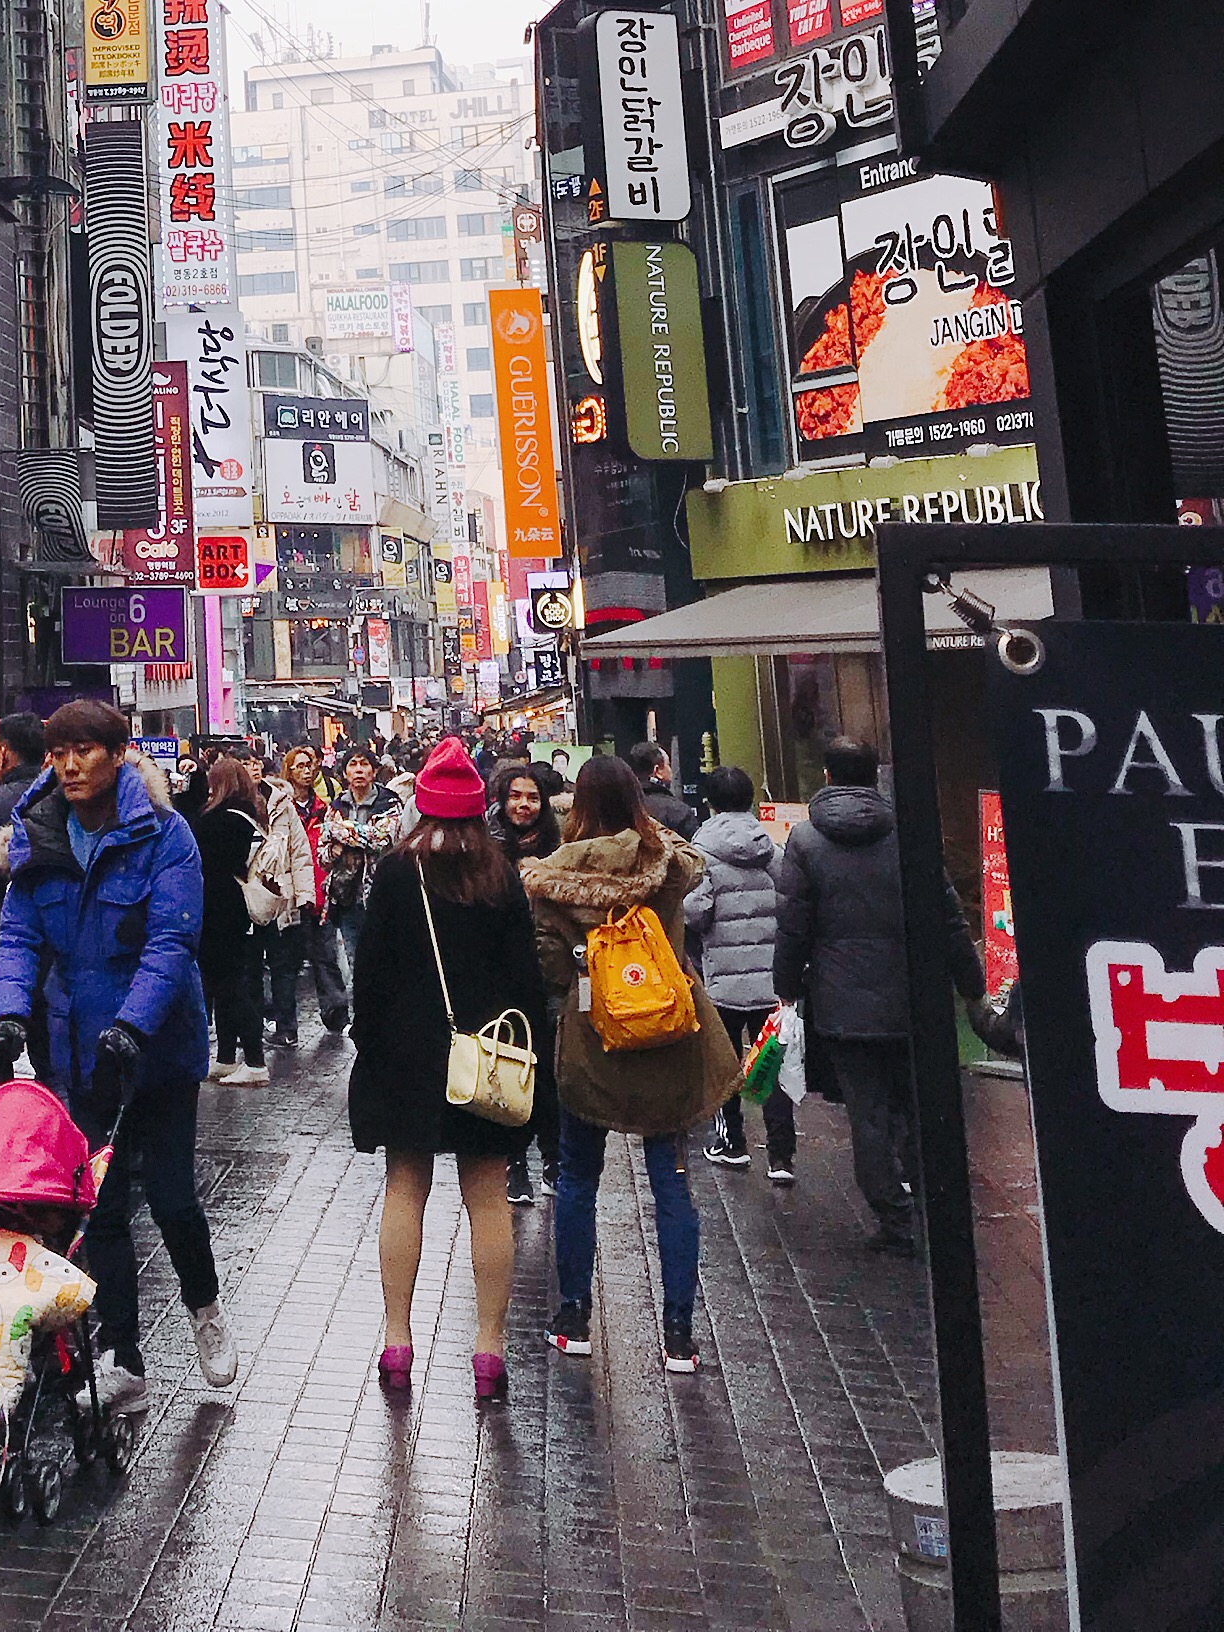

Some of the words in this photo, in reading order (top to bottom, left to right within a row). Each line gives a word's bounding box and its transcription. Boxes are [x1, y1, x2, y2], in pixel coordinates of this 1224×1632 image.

[789, 5, 809, 24] YOU
[797, 18, 813, 36] EAT
[92, 44, 140, 52] IMPROVISED
[731, 32, 772, 59] Barbeque
[160, 82, 217, 114] 마라탕
[776, 24, 894, 149] 장인
[616, 18, 662, 214] 장인닭갈비
[168, 121, 216, 224] 米线
[588, 200, 604, 223] 2F
[167, 229, 225, 262] 쌀국수
[593, 240, 607, 261] 1F
[173, 268, 219, 281] 명동2호점
[645, 243, 670, 336] NATURE
[327, 294, 388, 312] HALALFOOD
[98, 271, 134, 374] FOLDER
[353, 311, 388, 321] RESTAURANT
[931, 307, 1005, 348] JANGIN
[450, 381, 460, 421] HALAL
[653, 344, 680, 455] REPUBLIC
[301, 408, 363, 431] 리안헤어
[928, 419, 986, 442] 1522-1960
[508, 354, 544, 509] GUÉRISSON
[453, 427, 464, 463] FOOD
[434, 451, 448, 506] RIAHN
[170, 518, 188, 535] 3F
[784, 497, 891, 544] NATURE
[514, 526, 554, 543] 九朵云
[136, 536, 179, 559] Café
[202, 543, 242, 561] ART
[203, 562, 239, 581] BOX
[74, 593, 127, 612] Lounge
[109, 611, 127, 623] on
[129, 593, 146, 624] 6
[544, 608, 565, 617] BODY
[495, 595, 507, 642] SKINFOOD
[545, 615, 566, 623] SHOP
[111, 627, 176, 658] BAR
[932, 634, 965, 649] NATURE
